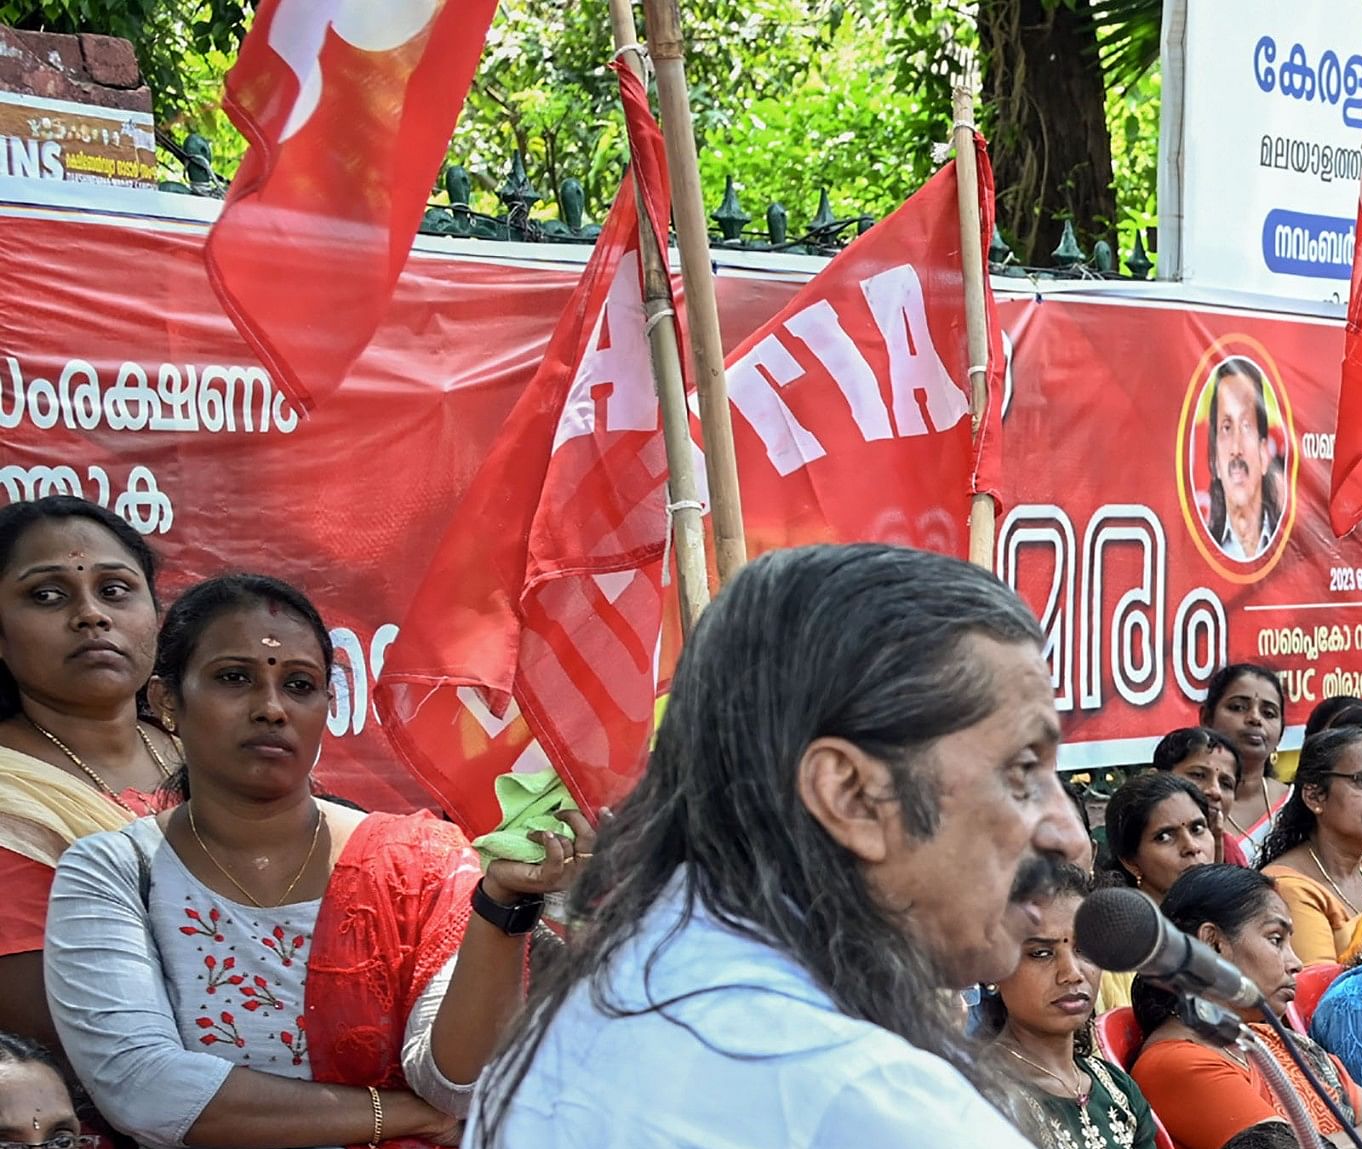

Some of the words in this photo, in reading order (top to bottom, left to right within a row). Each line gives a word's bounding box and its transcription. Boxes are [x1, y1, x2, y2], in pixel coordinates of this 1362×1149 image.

[1330, 567, 1354, 592] 2023
[997, 504, 1227, 712] മരം
[1277, 667, 1316, 703] TUC
